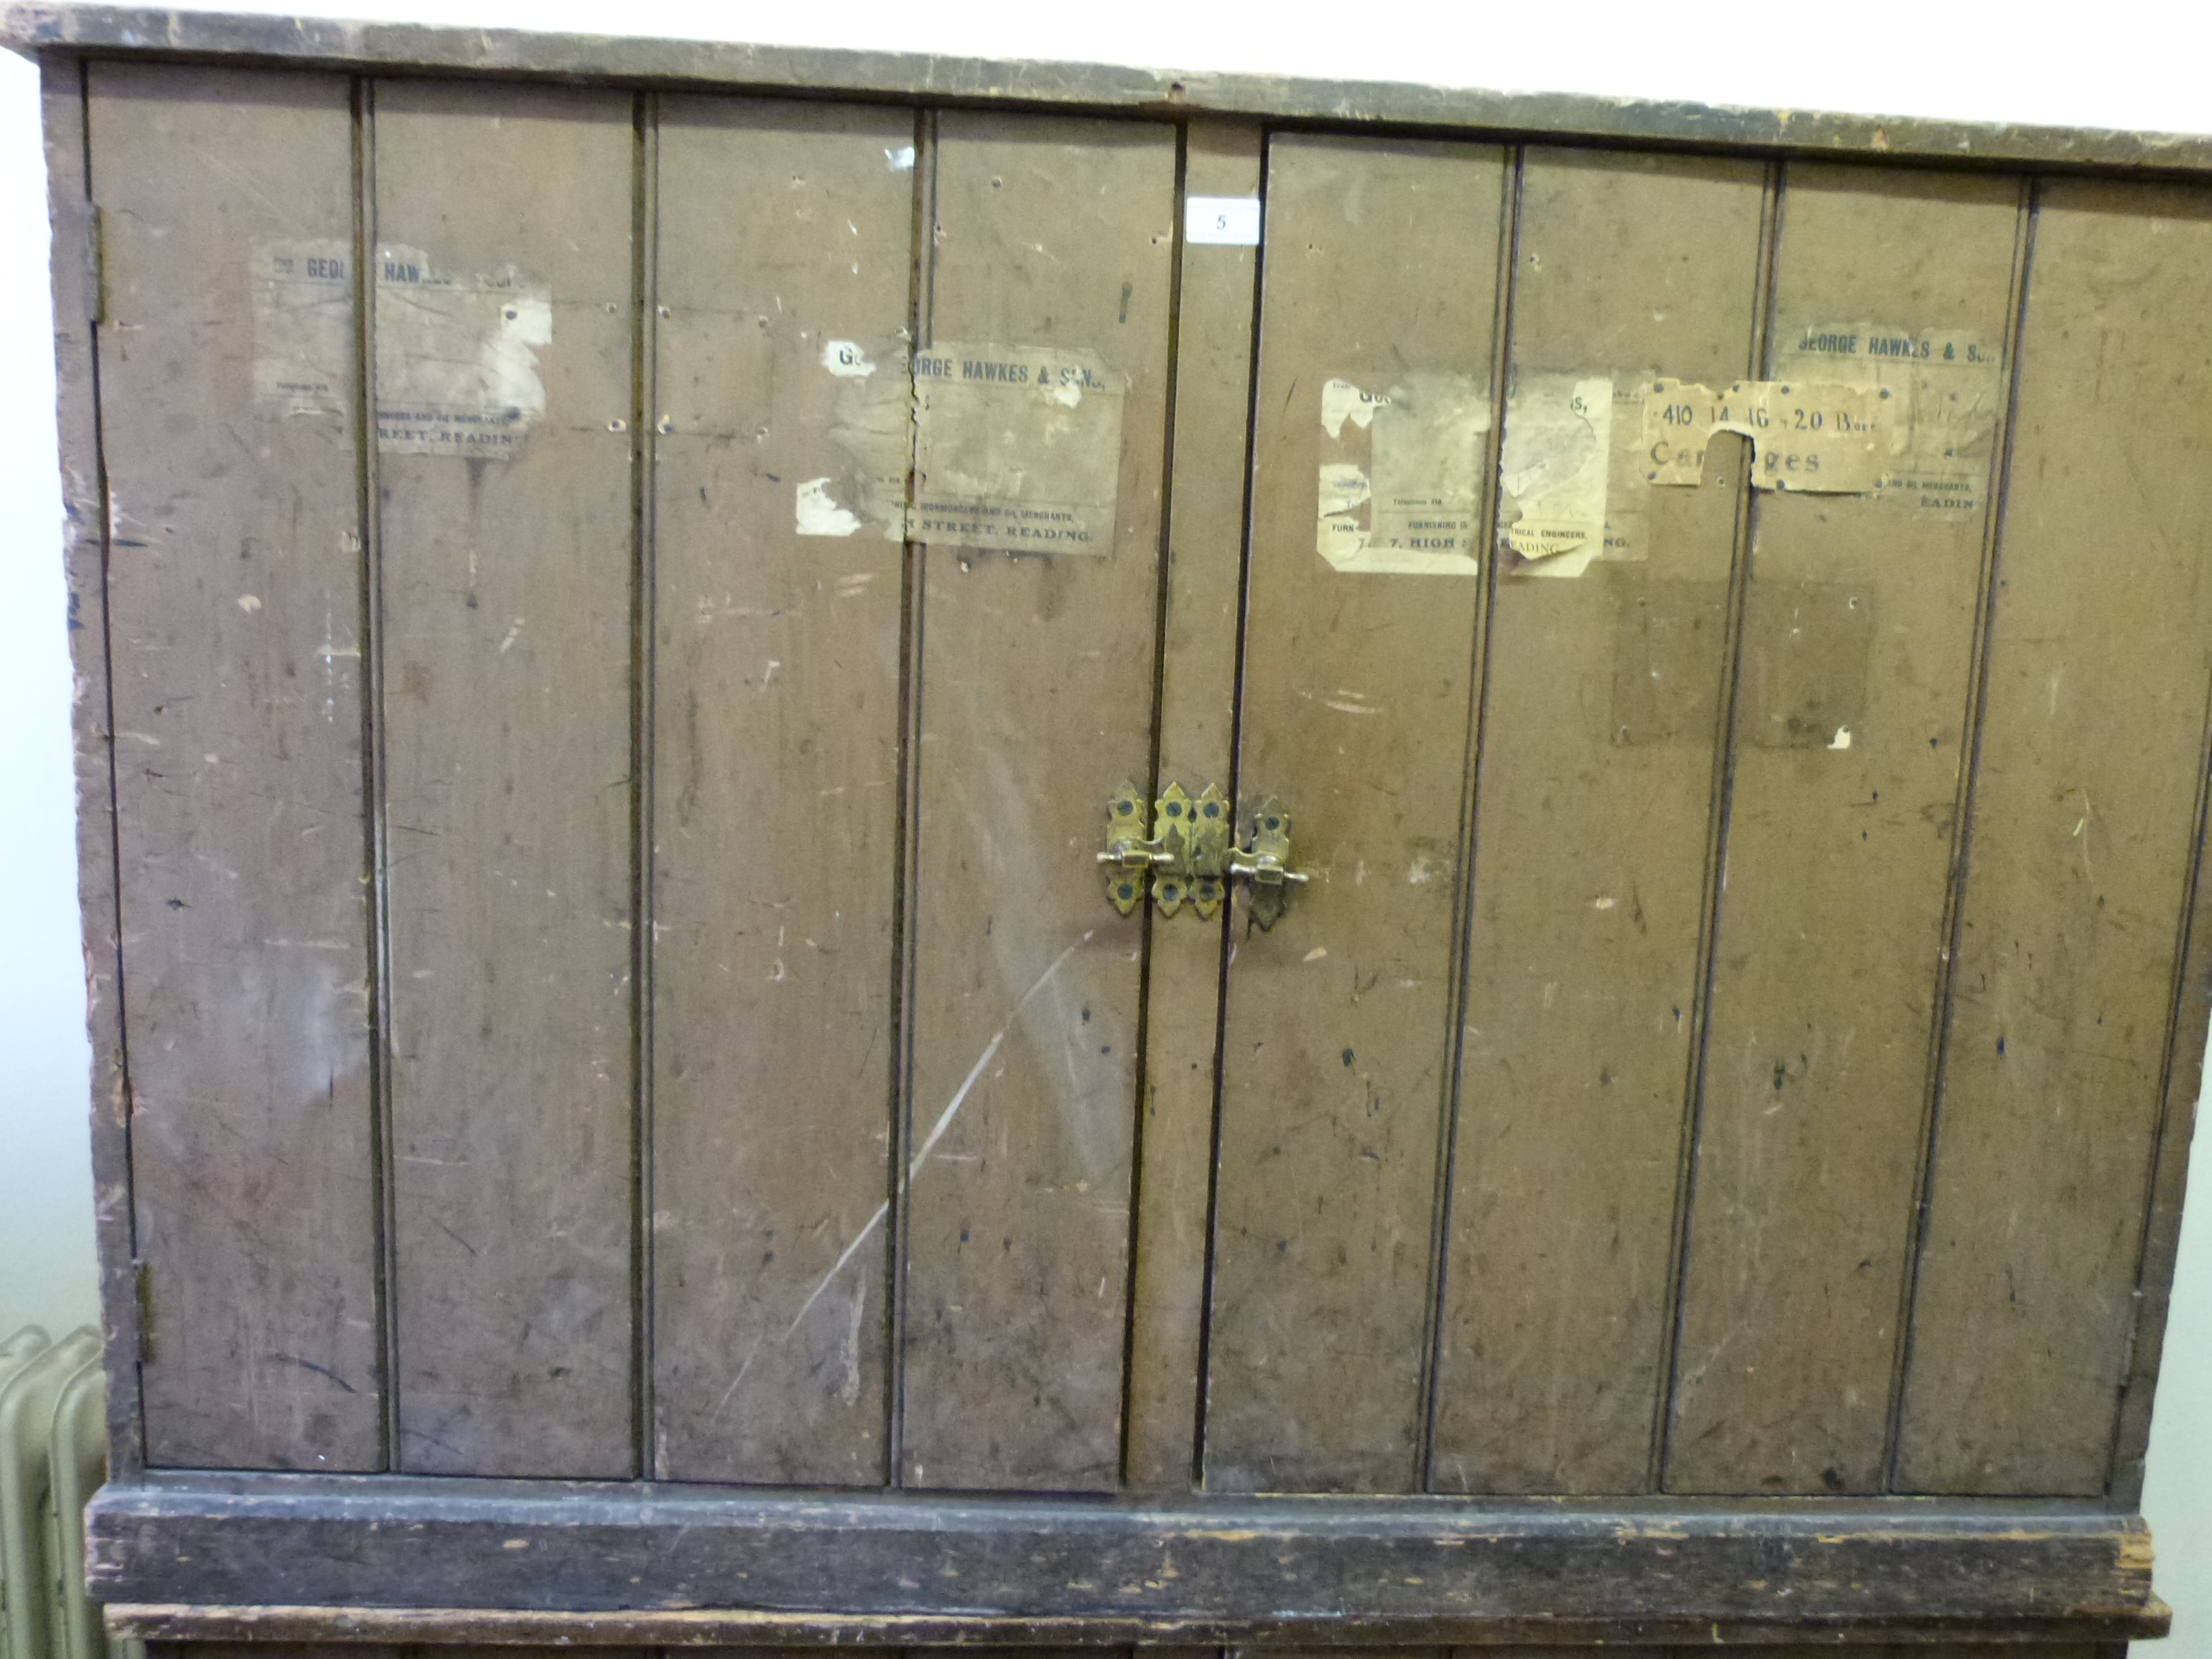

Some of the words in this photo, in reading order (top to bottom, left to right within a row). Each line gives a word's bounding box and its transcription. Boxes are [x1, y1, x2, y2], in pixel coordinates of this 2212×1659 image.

[1217, 214, 1227, 231] 5
[1943, 341, 1955, 360] &
[963, 359, 1028, 383] HAWKES
[1038, 365, 1050, 385] &
[1711, 405, 1729, 424] 14
[1748, 407, 1770, 429] 16
[1794, 408, 1824, 430] 20
[1332, 524, 1354, 533] FURN
[1410, 537, 1456, 550] HIGH
